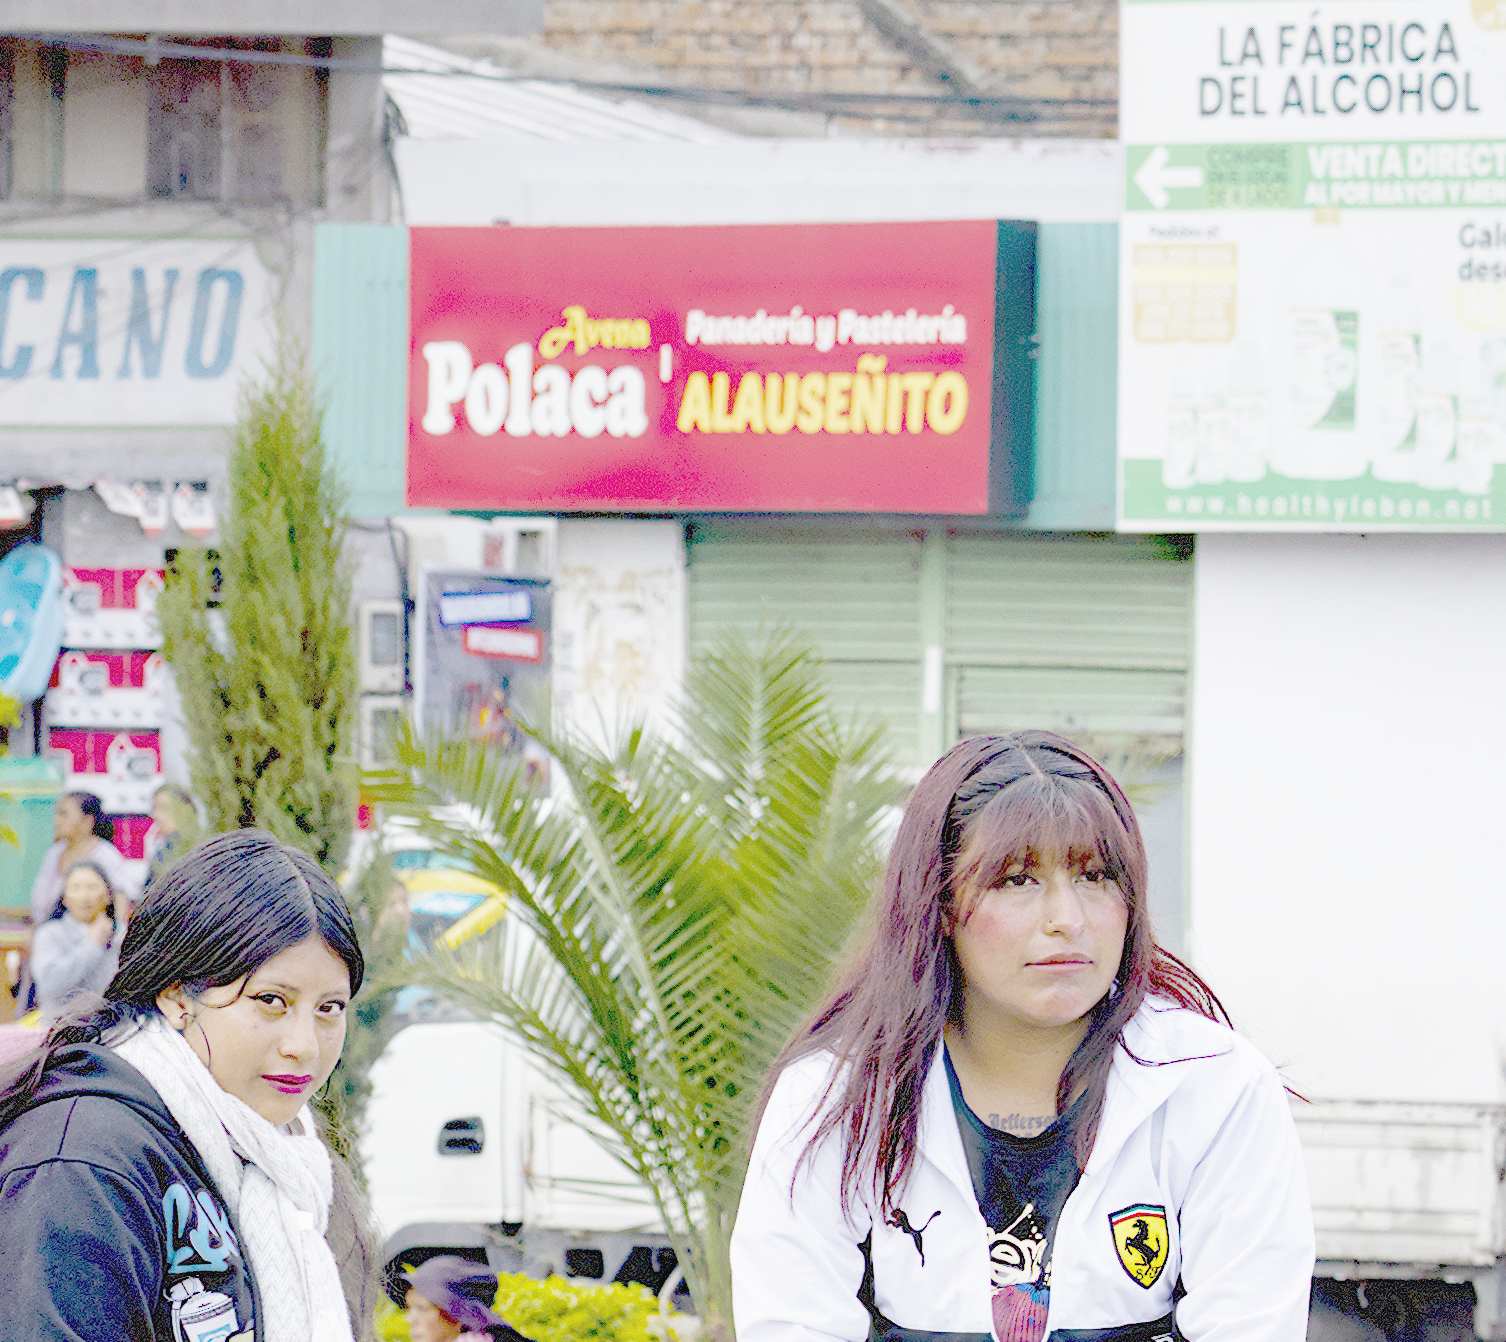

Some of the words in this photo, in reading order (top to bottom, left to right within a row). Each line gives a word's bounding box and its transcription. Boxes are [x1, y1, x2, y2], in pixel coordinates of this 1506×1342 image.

[1220, 25, 1264, 66] LA
[1278, 9, 1460, 66] FÁBRICA
[1199, 75, 1267, 117] DEL
[1282, 71, 1480, 115] ALCOHOL
[1307, 144, 1405, 179] VENTA
[1407, 141, 1506, 177] DIRECT
[1304, 182, 1329, 205] AL
[1332, 182, 1371, 205] POR
[1374, 181, 1446, 204] MAYOR
[1449, 180, 1462, 201] Y
[1464, 179, 1506, 202] MEN
[1457, 255, 1506, 284] des
[539, 306, 651, 359] Avena
[685, 307, 814, 346] Panadería
[815, 315, 836, 352] y
[837, 306, 967, 344] Pastelería
[422, 341, 648, 437] Polaca
[677, 353, 969, 435] ALAUSEÑITO
